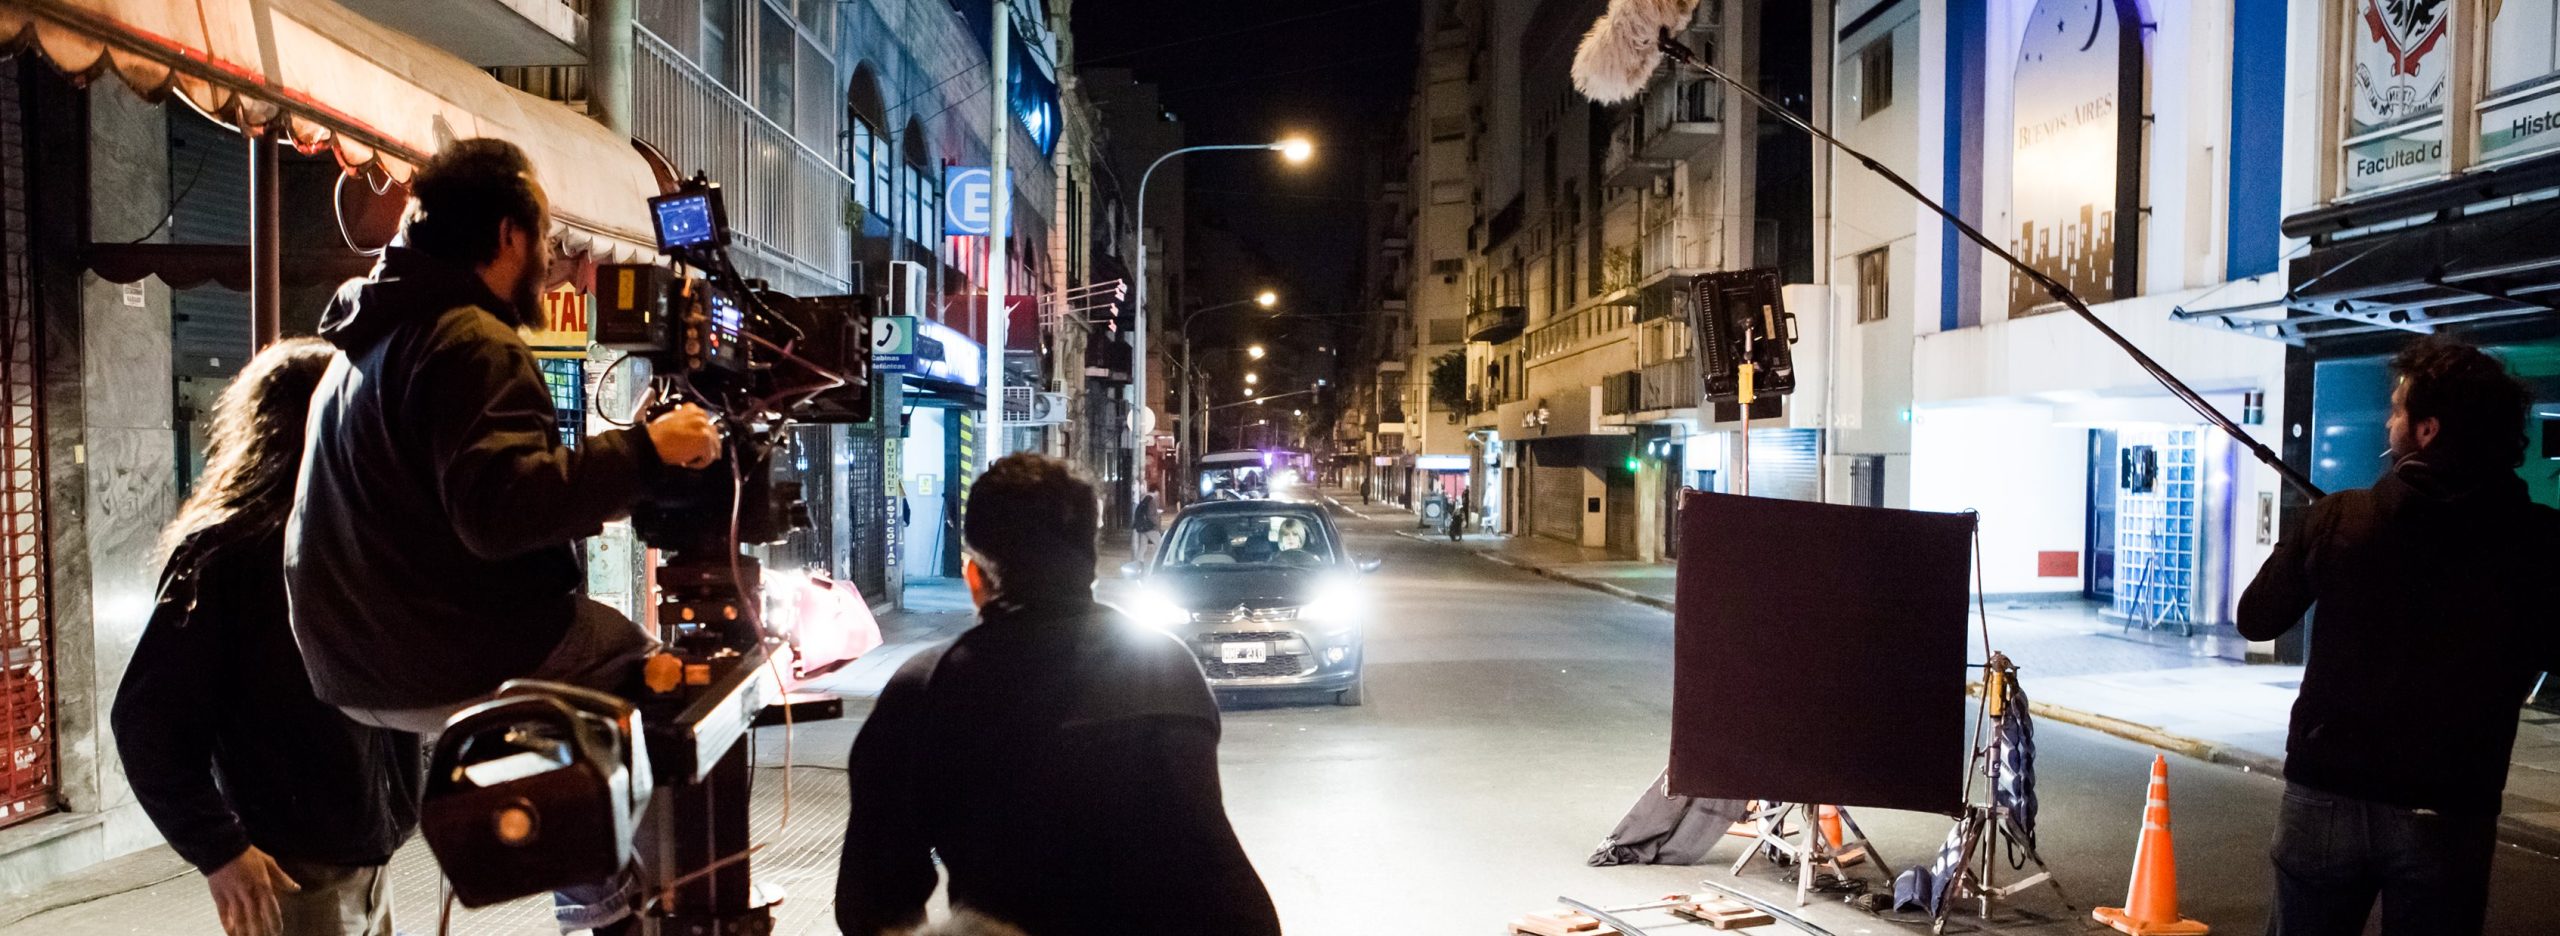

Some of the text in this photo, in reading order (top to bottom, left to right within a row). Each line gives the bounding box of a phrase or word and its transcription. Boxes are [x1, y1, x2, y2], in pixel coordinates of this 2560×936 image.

[2019, 92, 2112, 150] BUENOS AIRES
[2512, 110, 2560, 139] Histo
[2357, 143, 2426, 177] Facultad
[964, 183, 991, 222] E
[886, 441, 895, 492] INTERNET
